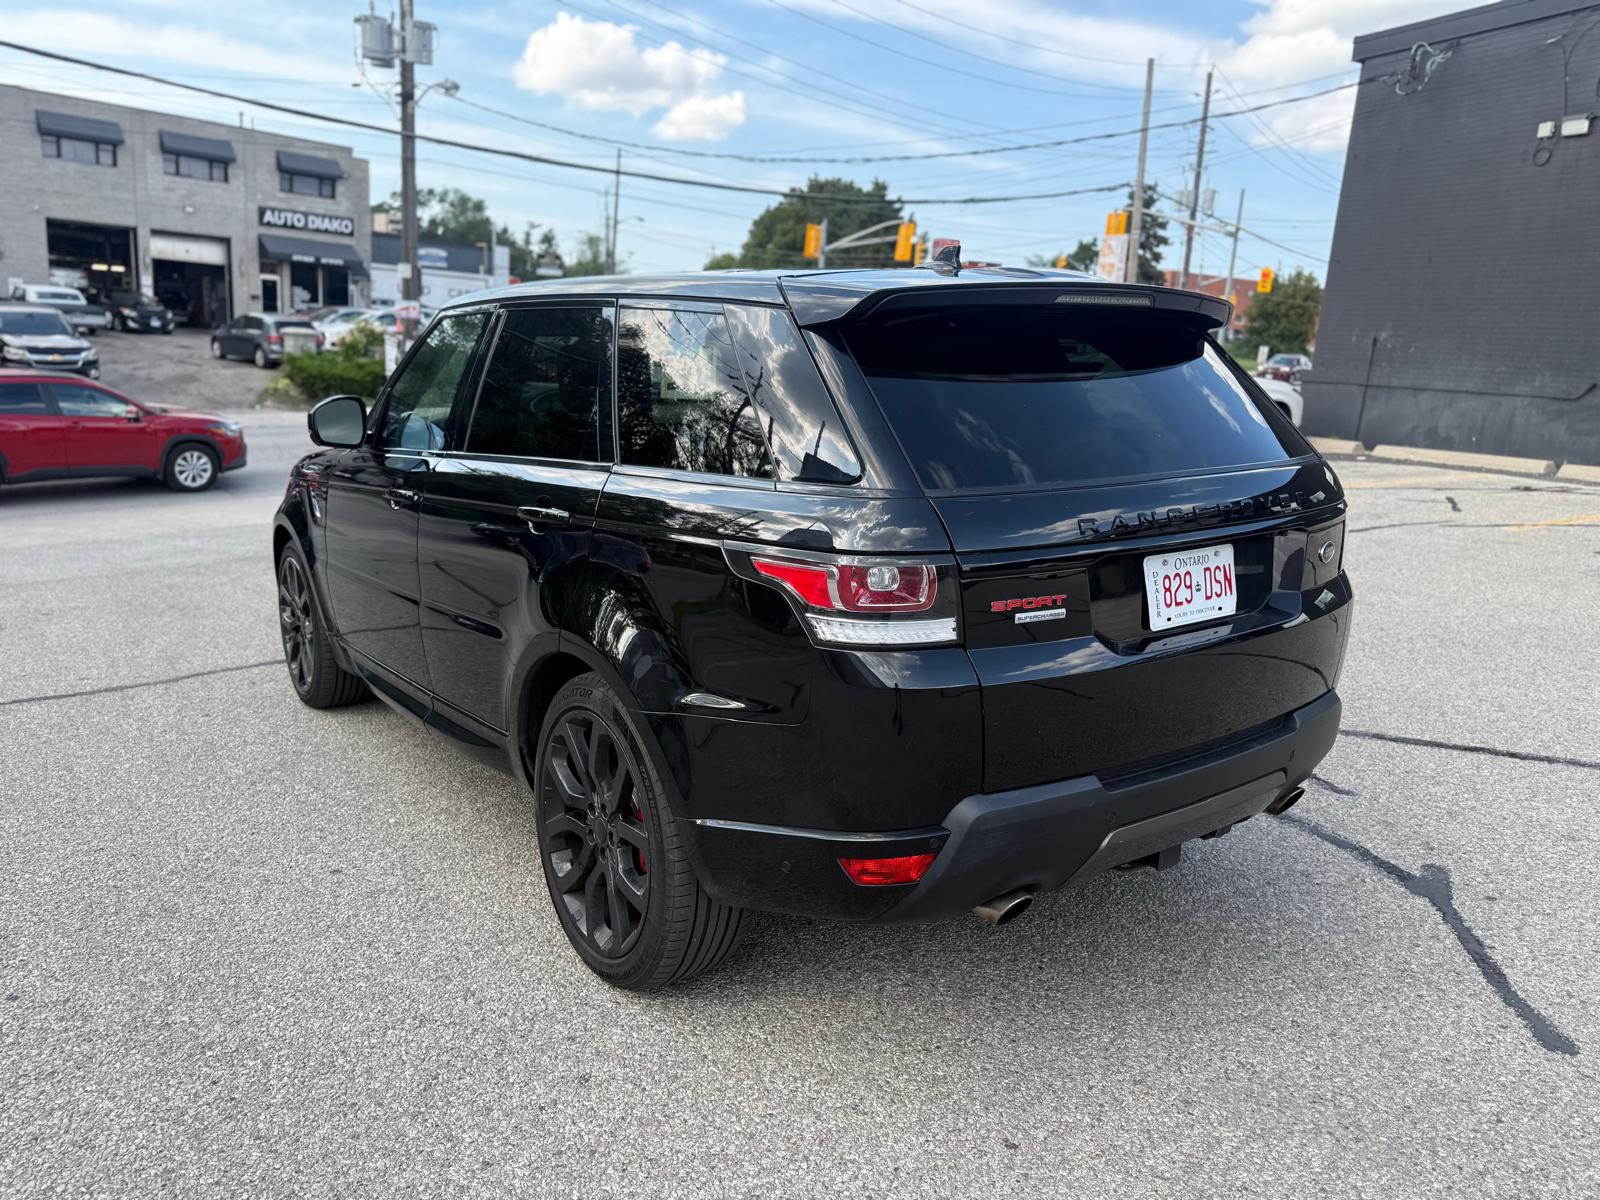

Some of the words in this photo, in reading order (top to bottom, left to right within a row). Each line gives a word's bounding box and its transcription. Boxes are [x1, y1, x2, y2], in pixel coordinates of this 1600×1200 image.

[263, 209, 306, 229] AUTO
[307, 214, 353, 234] DIAKO
[1077, 503, 1209, 537] RANGE
[1216, 491, 1308, 519] ROVER
[1174, 554, 1210, 571] ONTARIO
[1152, 571, 1162, 618] DEALER
[1162, 570, 1194, 608] 829
[1203, 563, 1233, 601] DSN
[991, 594, 1067, 612] SPORT
[1017, 611, 1065, 621] SUPERCHARGED
